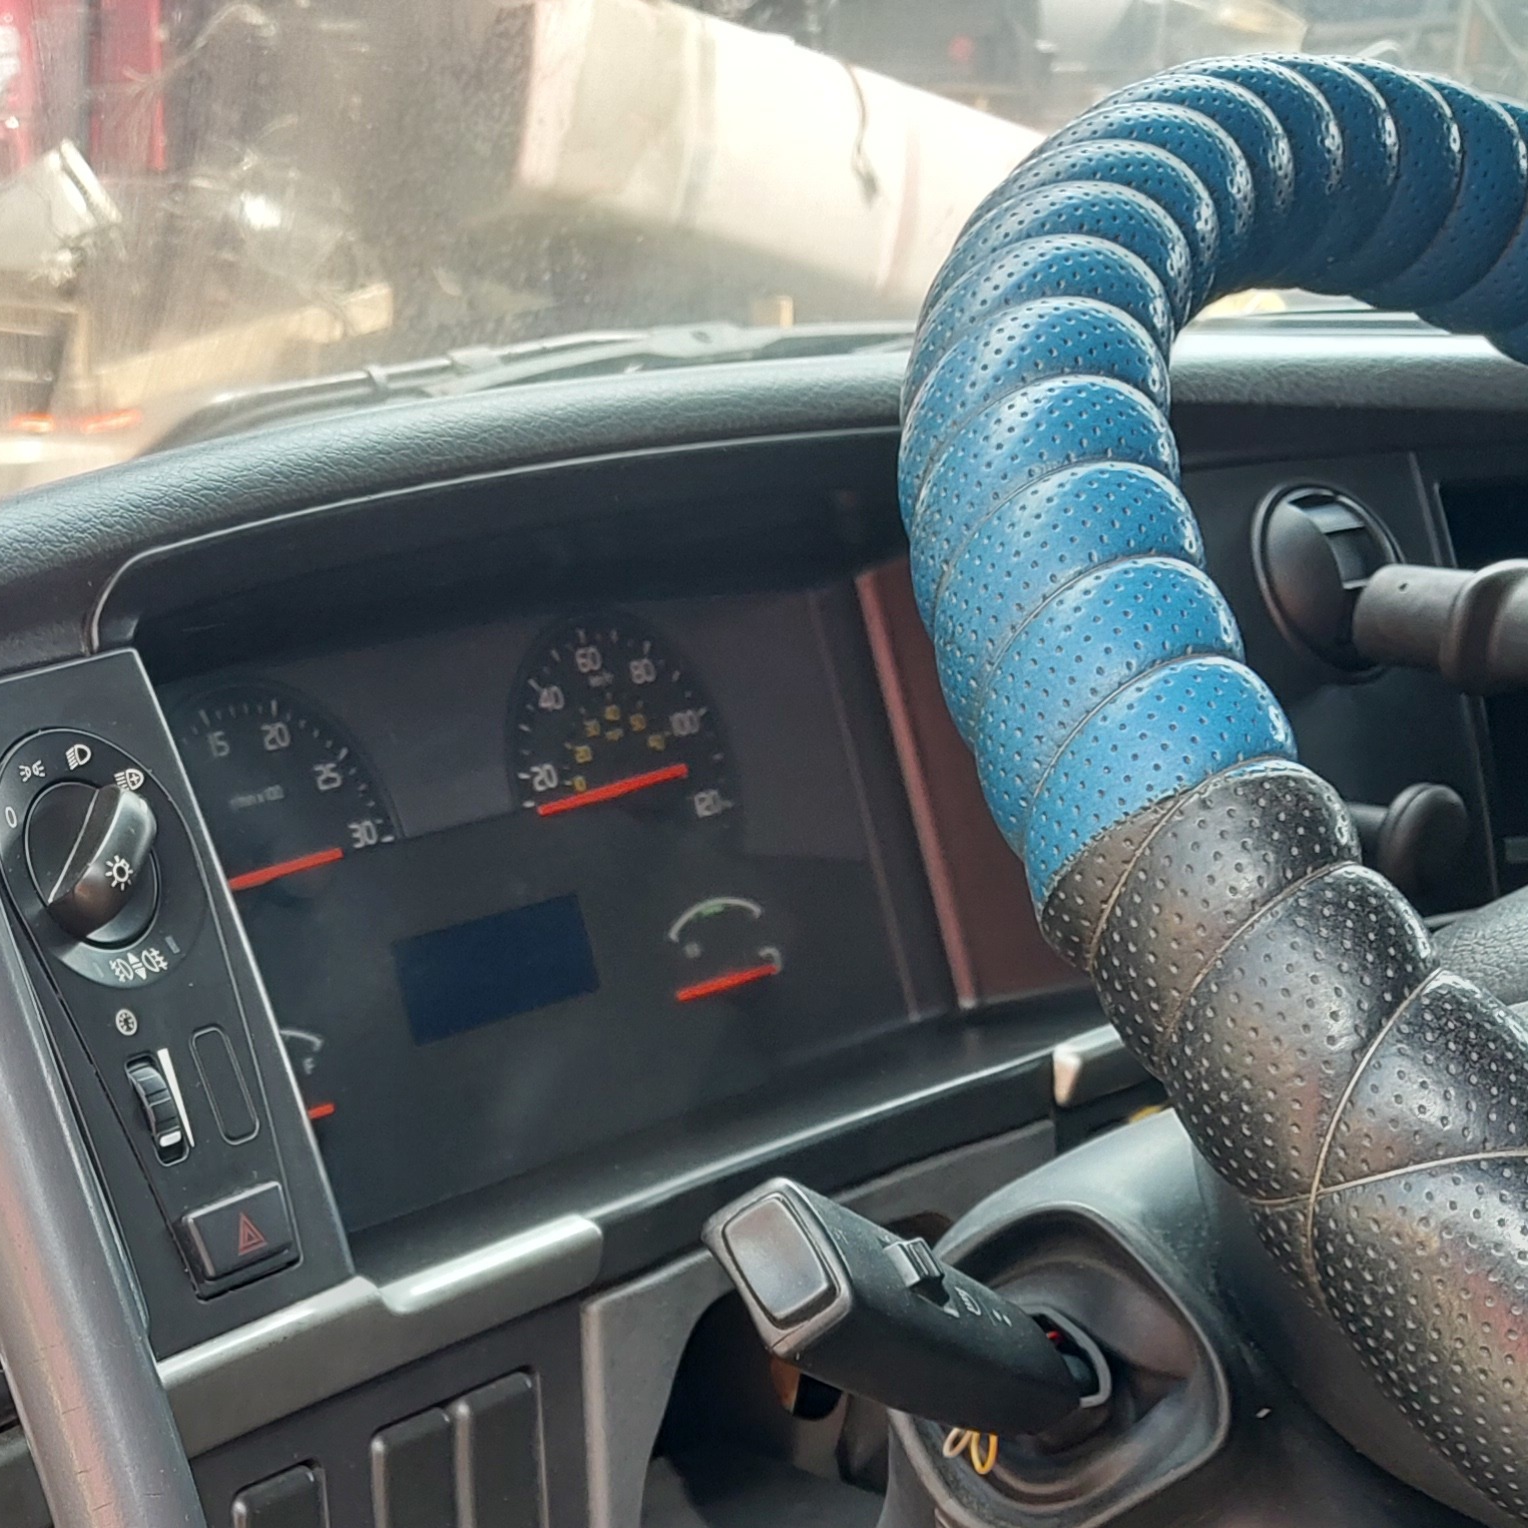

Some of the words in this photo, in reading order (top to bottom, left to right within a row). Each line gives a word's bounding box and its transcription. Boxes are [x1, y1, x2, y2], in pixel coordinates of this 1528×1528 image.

[575, 646, 602, 673] 60
[629, 658, 656, 684] 80
[208, 731, 230, 757] 15
[260, 722, 291, 750] 20
[313, 763, 342, 790] 25
[530, 763, 558, 791] 20
[348, 820, 378, 848] 30
